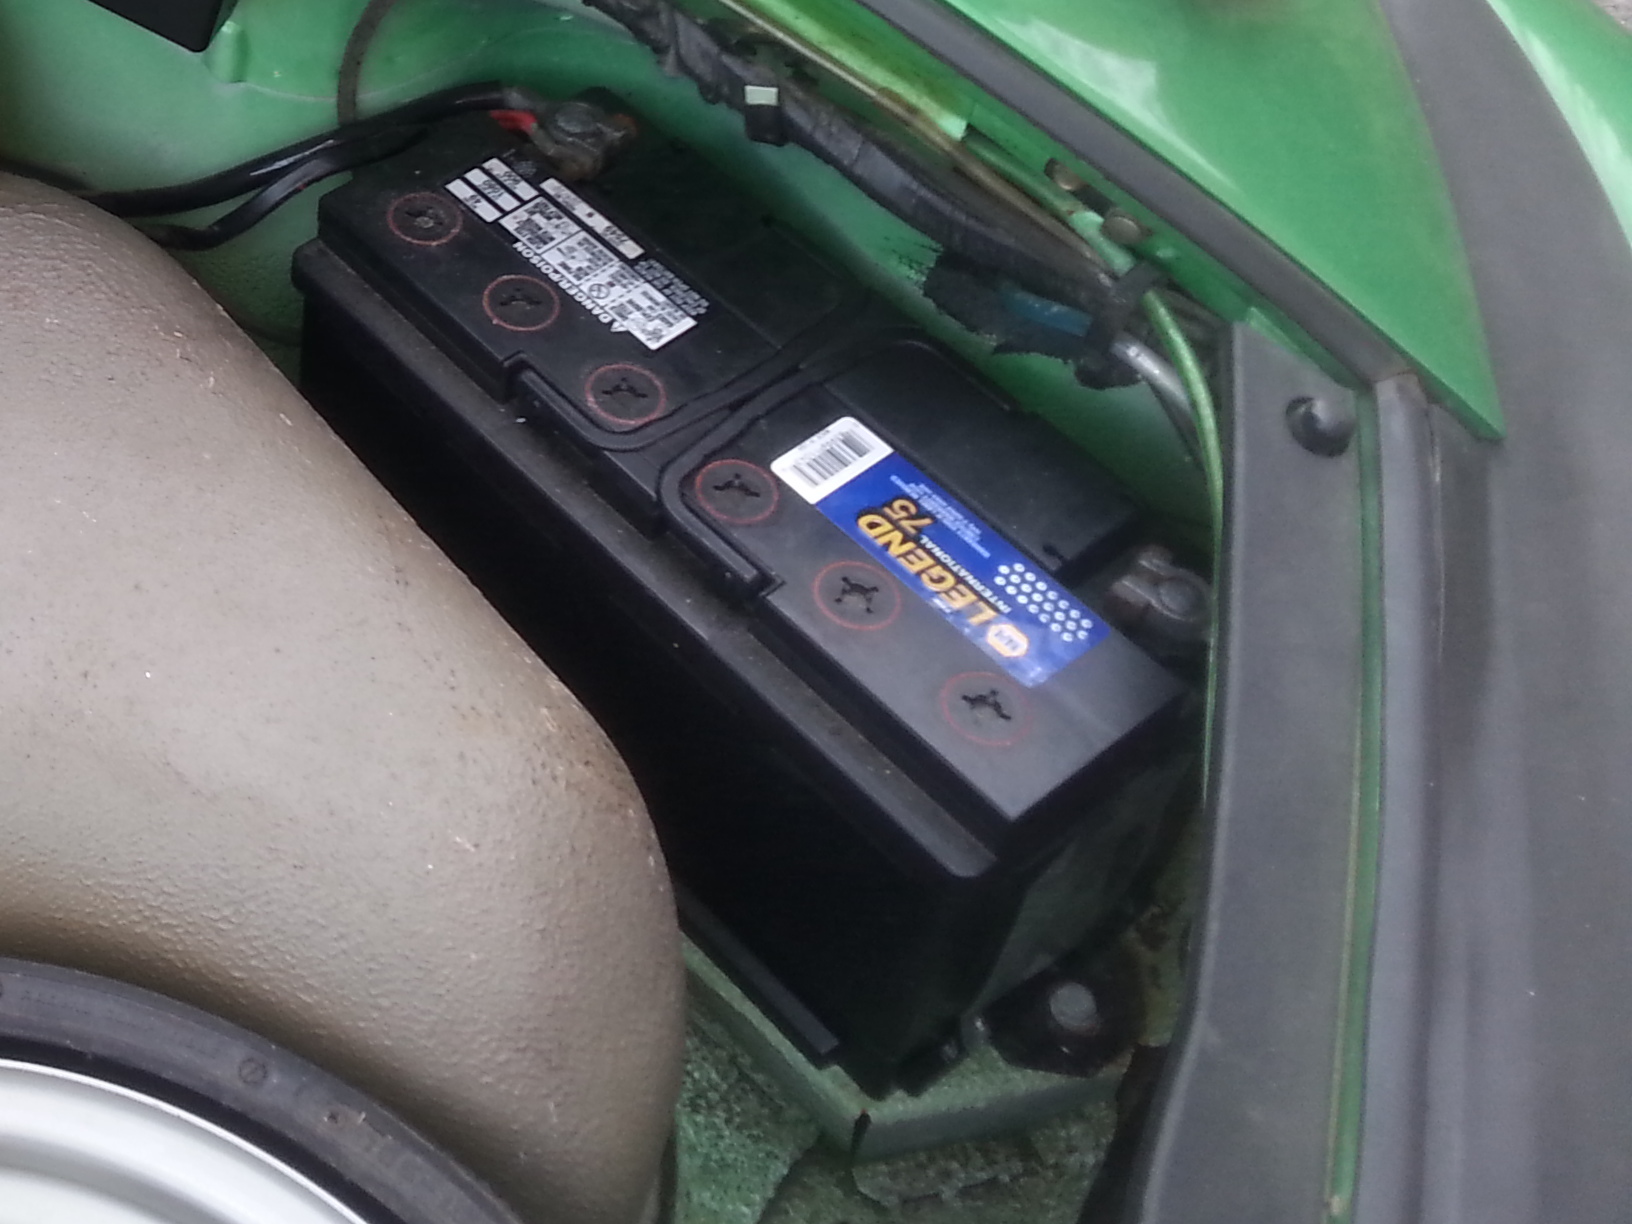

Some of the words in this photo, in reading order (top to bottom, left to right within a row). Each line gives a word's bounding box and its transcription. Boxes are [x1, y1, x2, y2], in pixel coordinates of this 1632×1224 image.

[886, 497, 933, 534] 75
[857, 512, 997, 625] LEGEND
[916, 532, 1013, 613] INTERNATIONAL
